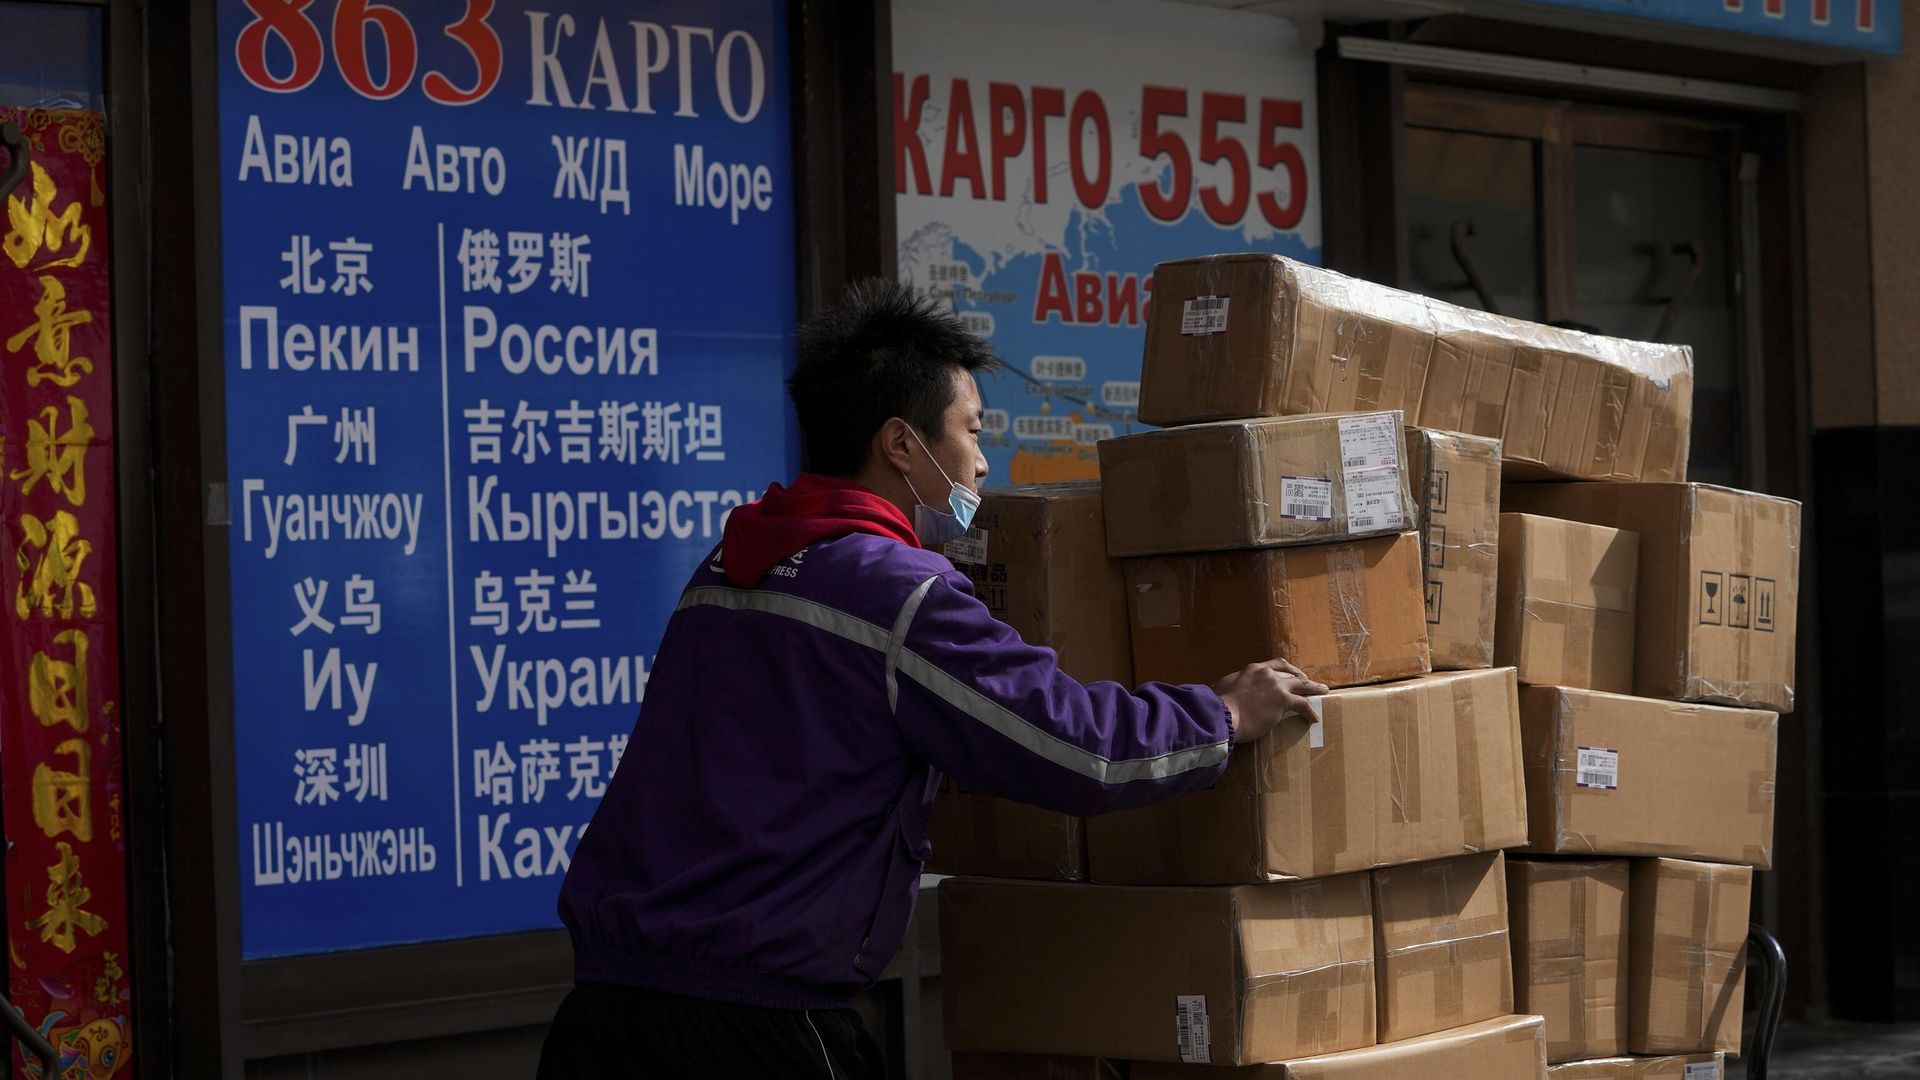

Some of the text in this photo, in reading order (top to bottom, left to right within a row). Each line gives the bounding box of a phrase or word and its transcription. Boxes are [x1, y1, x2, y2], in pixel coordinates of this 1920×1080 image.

[235, 0, 766, 123] 863 КАРГО
[239, 116, 771, 224] Авиа Авто Ж/Д Море
[893, 72, 1308, 230] КАРГО 555
[281, 236, 372, 295] 北京
[458, 229, 590, 296] 俄罗斯
[241, 306, 418, 371] Пекин
[465, 306, 657, 374] Россия
[285, 406, 375, 465] 广州
[464, 400, 724, 464] 吉尔吉斯斯坦
[244, 479, 422, 558] Гуанчжоу
[469, 476, 768, 557] Кыргыэста
[291, 575, 380, 635] 义乌
[471, 570, 600, 634] 乌克兰
[769, 565, 799, 579] PRESS
[304, 648, 377, 725] Иу
[295, 744, 386, 804] 深圳
[254, 823, 437, 885] Шэньчжэнь
[479, 813, 590, 881] Ках
